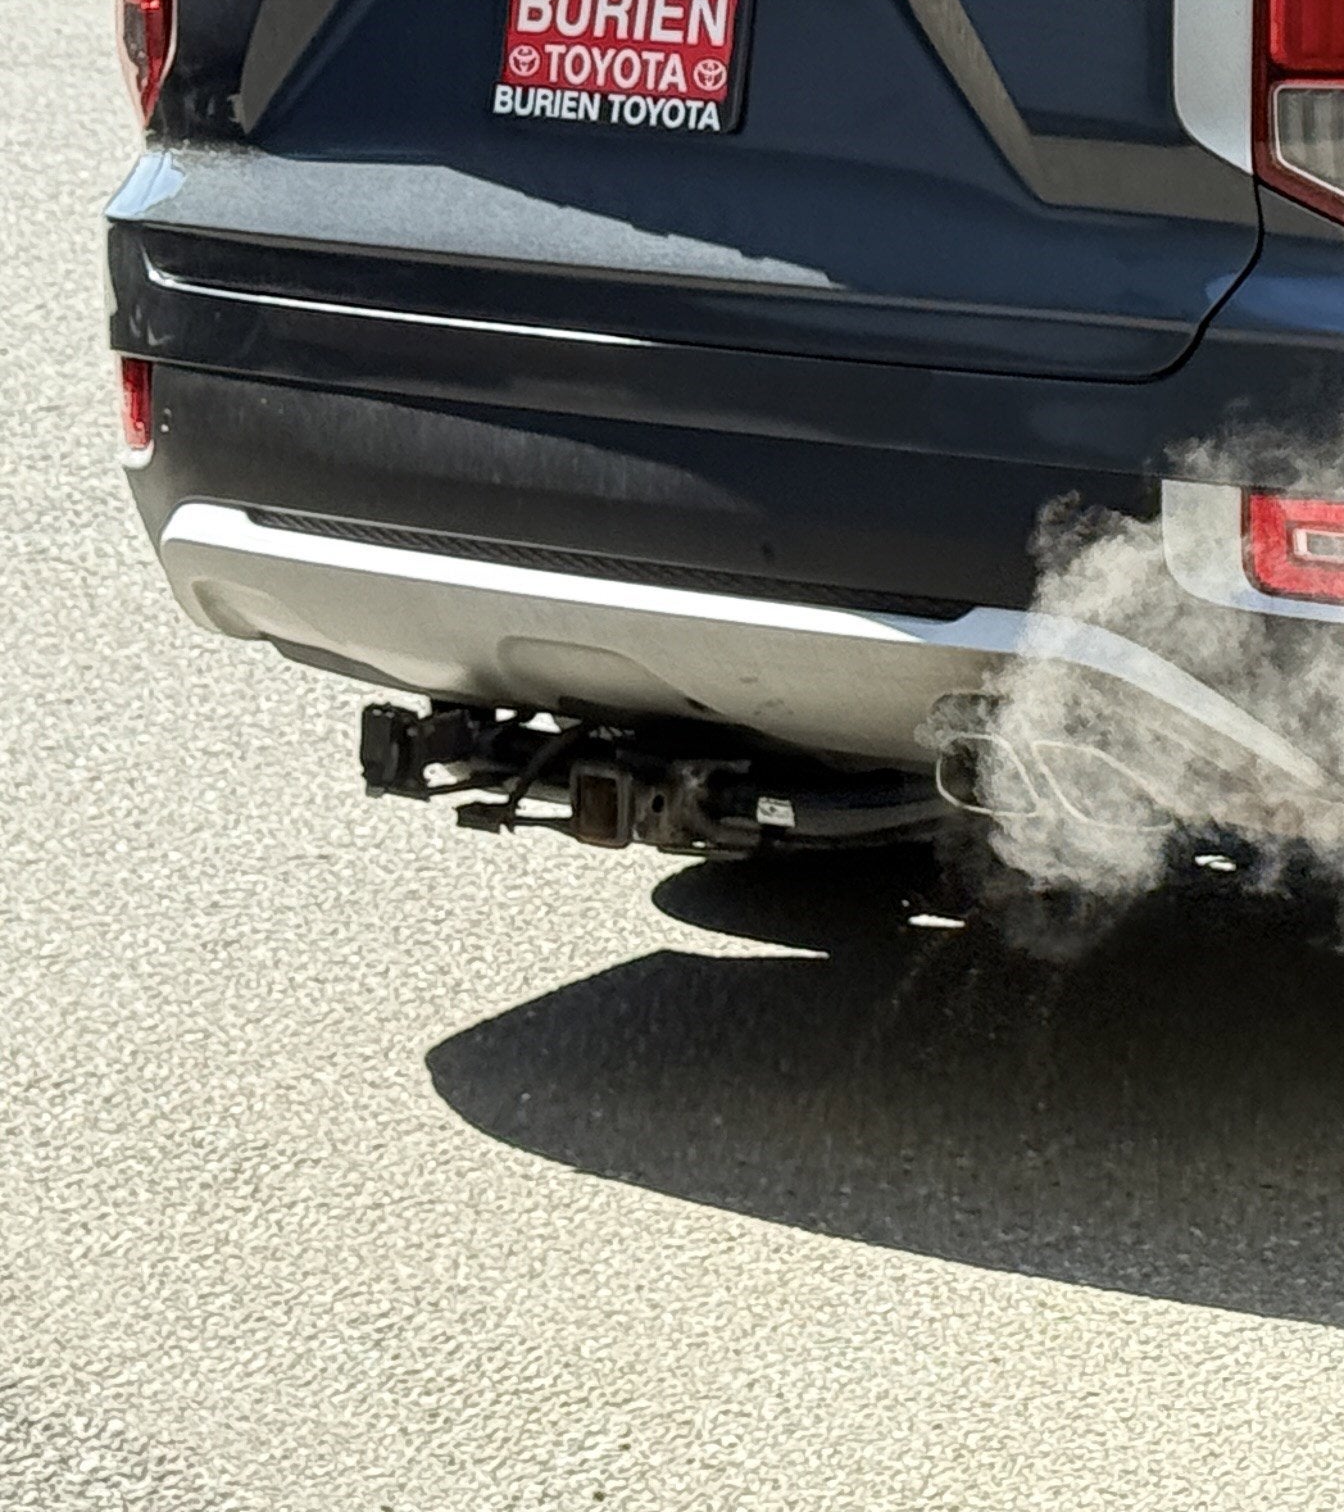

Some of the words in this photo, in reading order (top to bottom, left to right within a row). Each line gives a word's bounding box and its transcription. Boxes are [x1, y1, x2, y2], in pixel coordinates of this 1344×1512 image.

[544, 43, 688, 93] TOYOTA
[493, 84, 601, 123] BURIEN
[608, 93, 721, 132] TOYOTA
